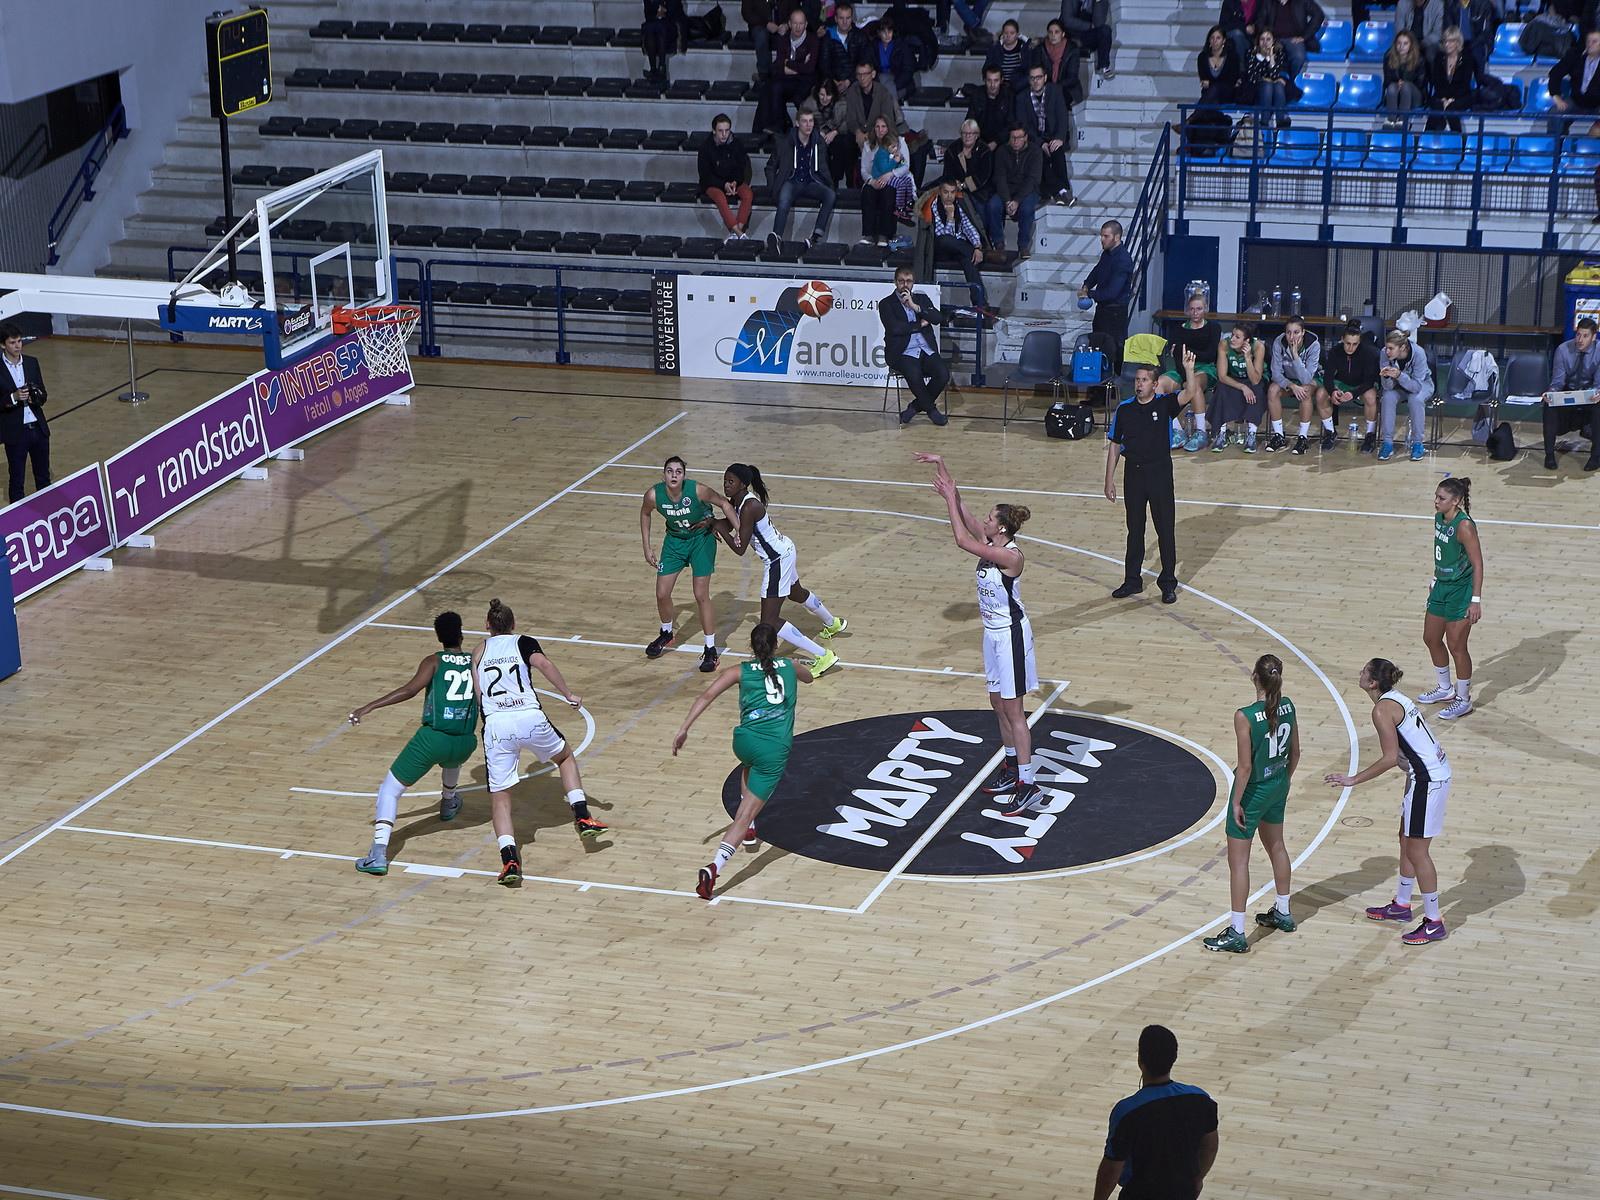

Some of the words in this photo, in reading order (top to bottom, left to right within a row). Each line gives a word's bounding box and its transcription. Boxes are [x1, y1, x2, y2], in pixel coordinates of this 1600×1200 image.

[1077, 130, 1085, 141] E
[1040, 237, 1048, 248] C
[656, 281, 663, 295] DE
[850, 299, 864, 310] 02
[657, 300, 666, 369] ENTREPRISE
[663, 281, 676, 370] COUVERTURE
[280, 326, 397, 405] INTERSP
[715, 327, 889, 368] Marolle
[304, 395, 331, 422] l'atoll
[344, 382, 369, 404] Angers
[157, 397, 260, 499] randstad
[5, 495, 101, 575] appa
[444, 668, 474, 701] 22
[484, 663, 525, 698] 21
[764, 674, 785, 705] 9
[1264, 722, 1291, 759] 12
[816, 717, 984, 848] MARTY
